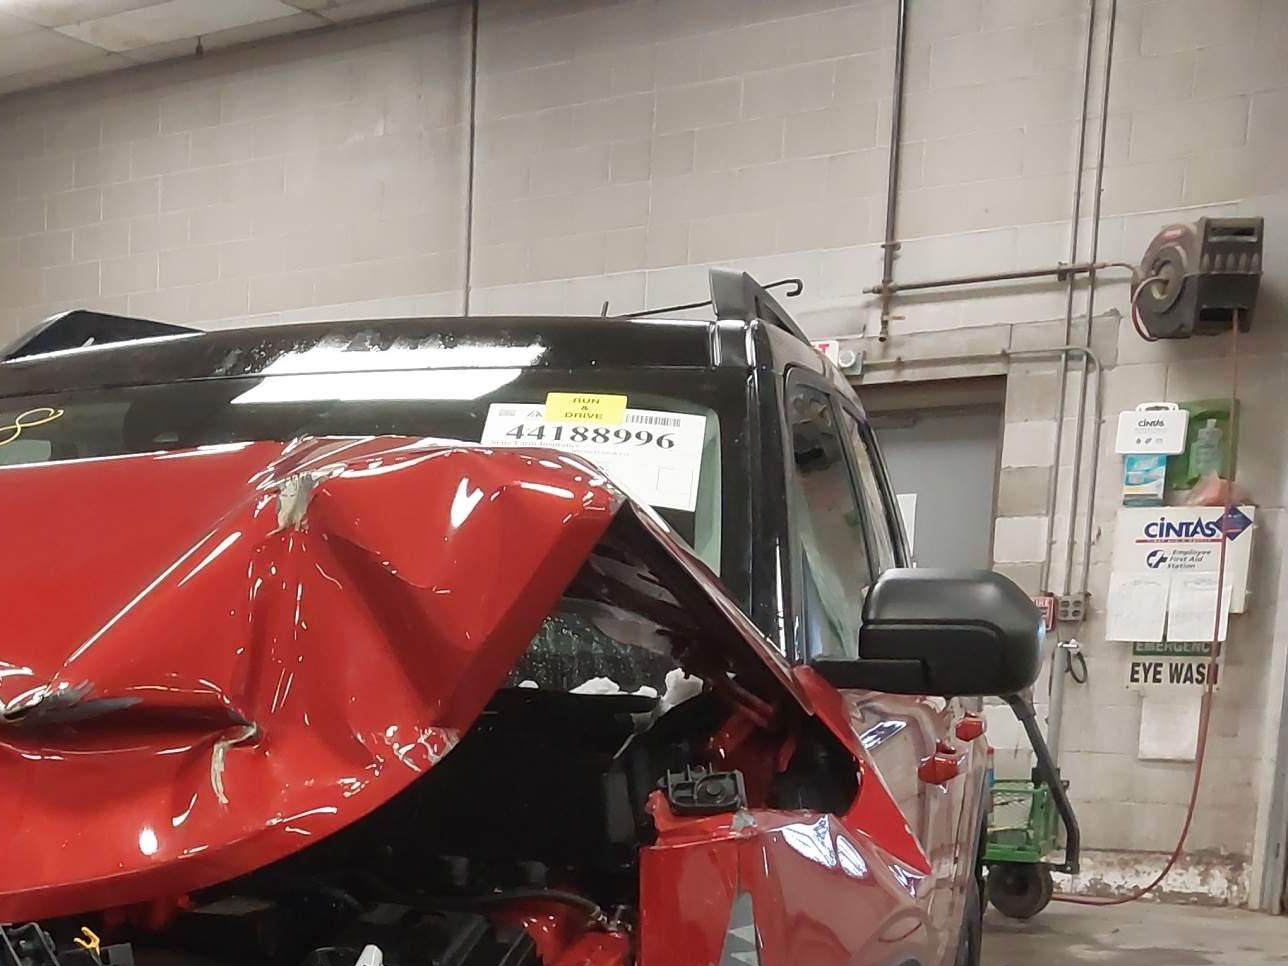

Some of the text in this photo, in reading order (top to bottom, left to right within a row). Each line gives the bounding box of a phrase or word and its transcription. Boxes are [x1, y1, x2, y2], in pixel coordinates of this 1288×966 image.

[572, 397, 600, 405] RUN
[564, 411, 603, 420] DRIVE
[505, 423, 676, 450] 44188996
[1171, 548, 1212, 557] Employee
[1168, 555, 1204, 563] First Aid
[1167, 562, 1196, 570] Station
[1135, 641, 1212, 652] EMERGENC
[1129, 662, 1164, 684] EYE
